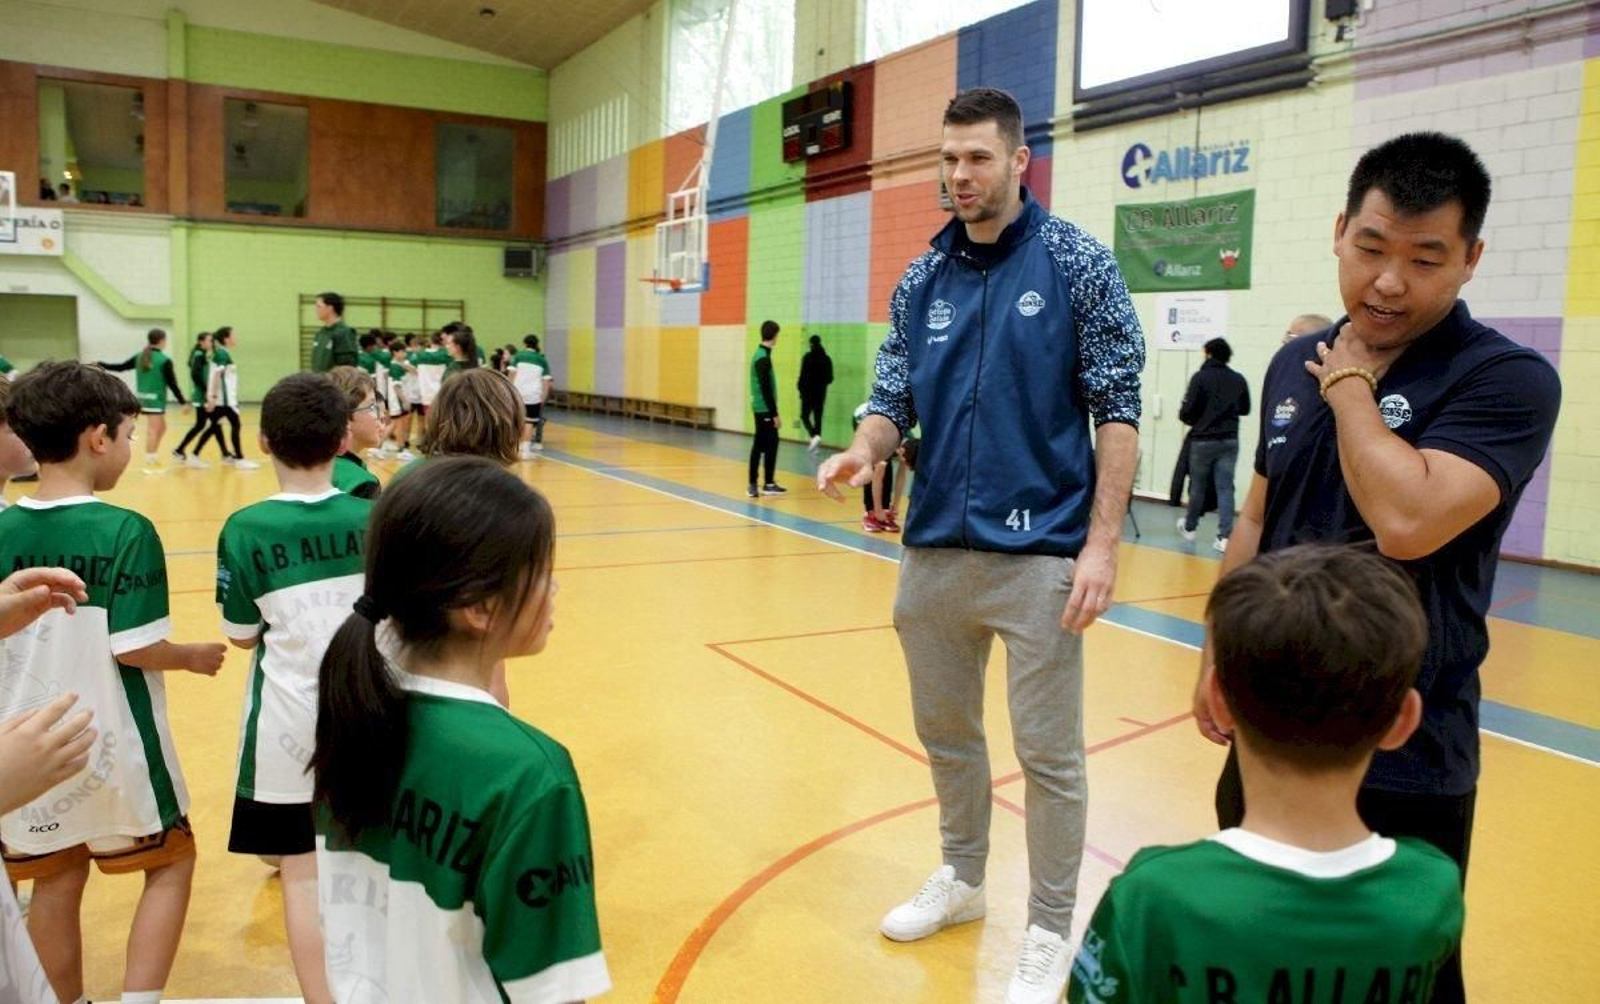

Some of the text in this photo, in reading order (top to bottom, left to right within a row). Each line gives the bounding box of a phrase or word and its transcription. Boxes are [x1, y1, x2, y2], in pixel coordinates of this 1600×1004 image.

[1151, 147, 1250, 184] Allariz
[1162, 203, 1239, 230] Allariz
[1005, 508, 1031, 531] 41
[252, 529, 367, 575] C.B. ALLA
[391, 788, 484, 875] ARIZ
